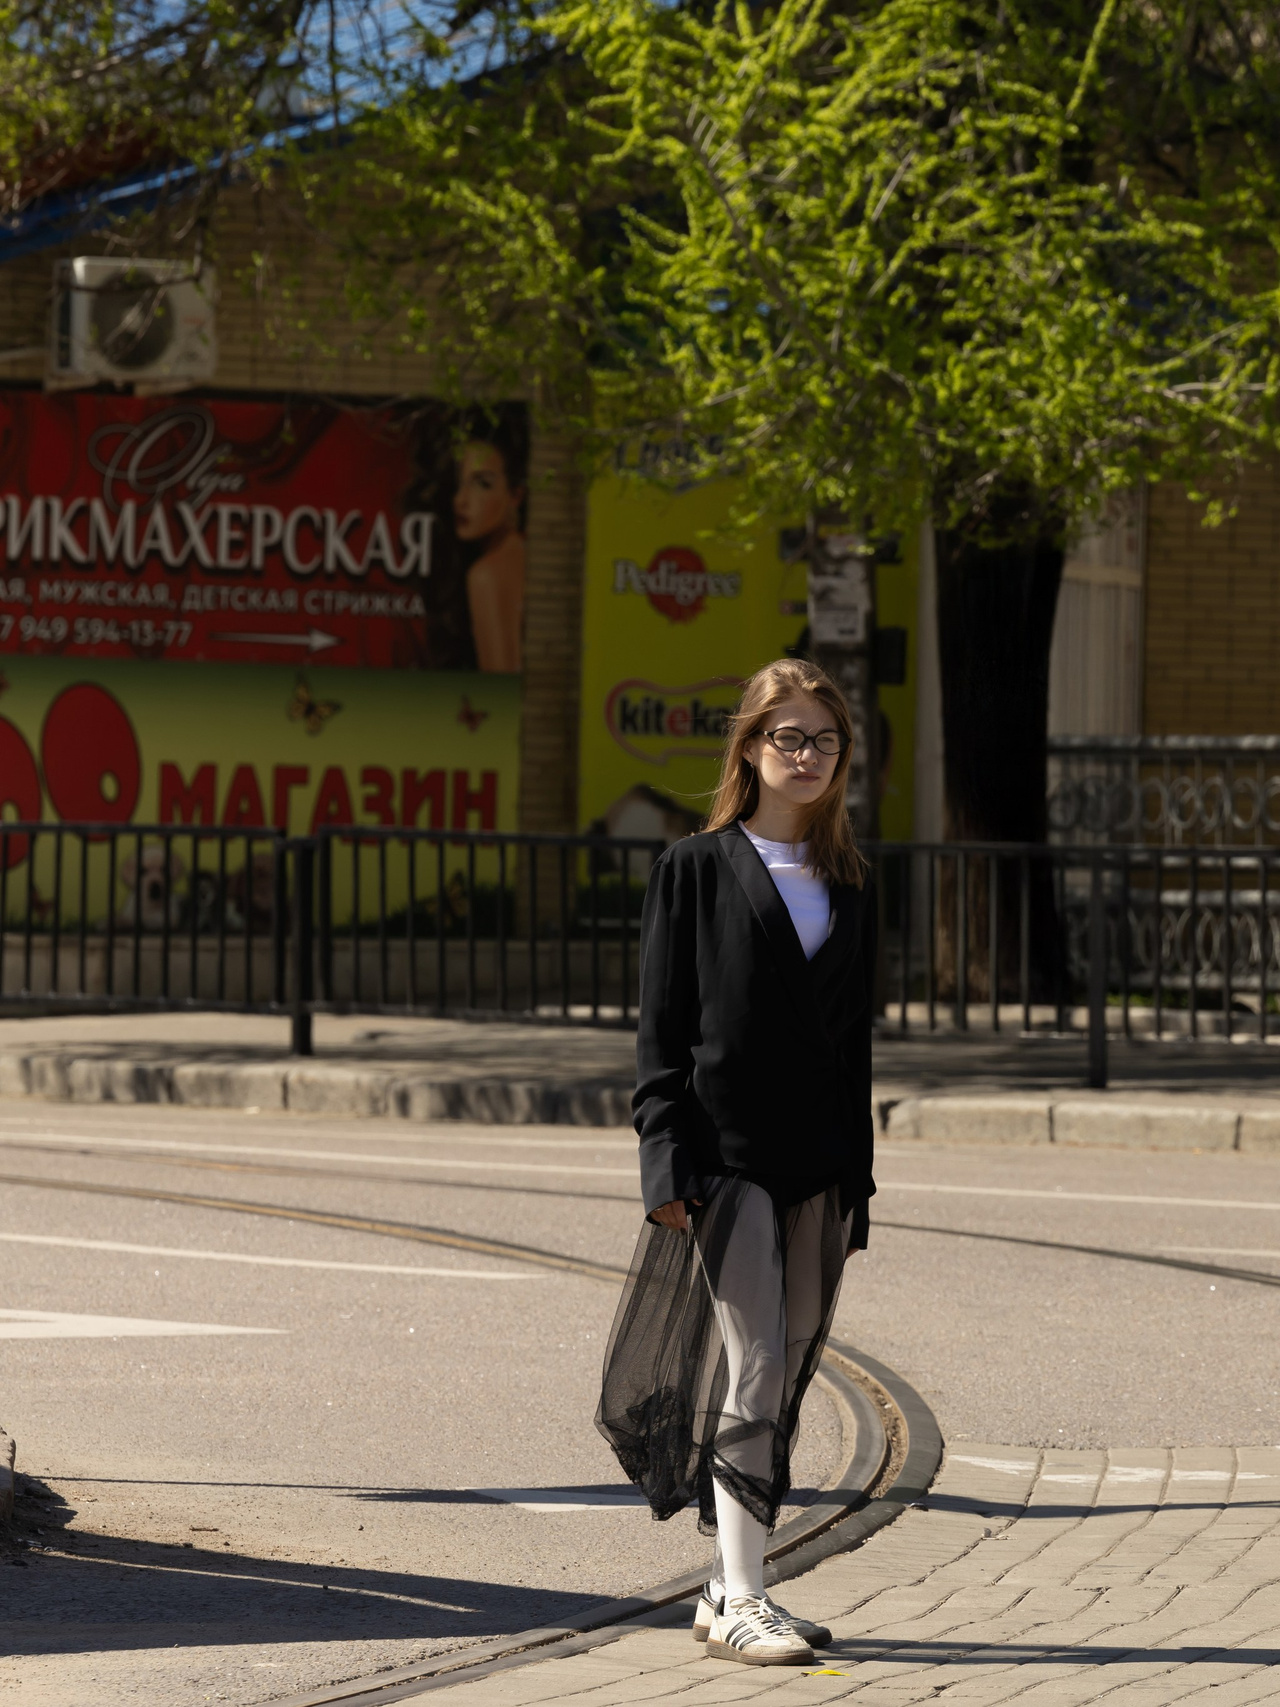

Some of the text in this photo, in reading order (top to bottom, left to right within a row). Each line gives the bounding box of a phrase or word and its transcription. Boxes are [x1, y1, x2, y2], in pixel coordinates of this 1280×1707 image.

[0, 493, 436, 578] ИКМАХЕРСКАЯ
[181, 584, 299, 615] ДЕТСКАЯ
[303, 588, 427, 618] СТРИЖКА
[613, 558, 742, 606] Pedigree
[20, 615, 68, 644] 949
[73, 617, 193, 648] 594-13-77
[620, 697, 732, 738] kiteka
[160, 761, 498, 848] МАГАЗИН
